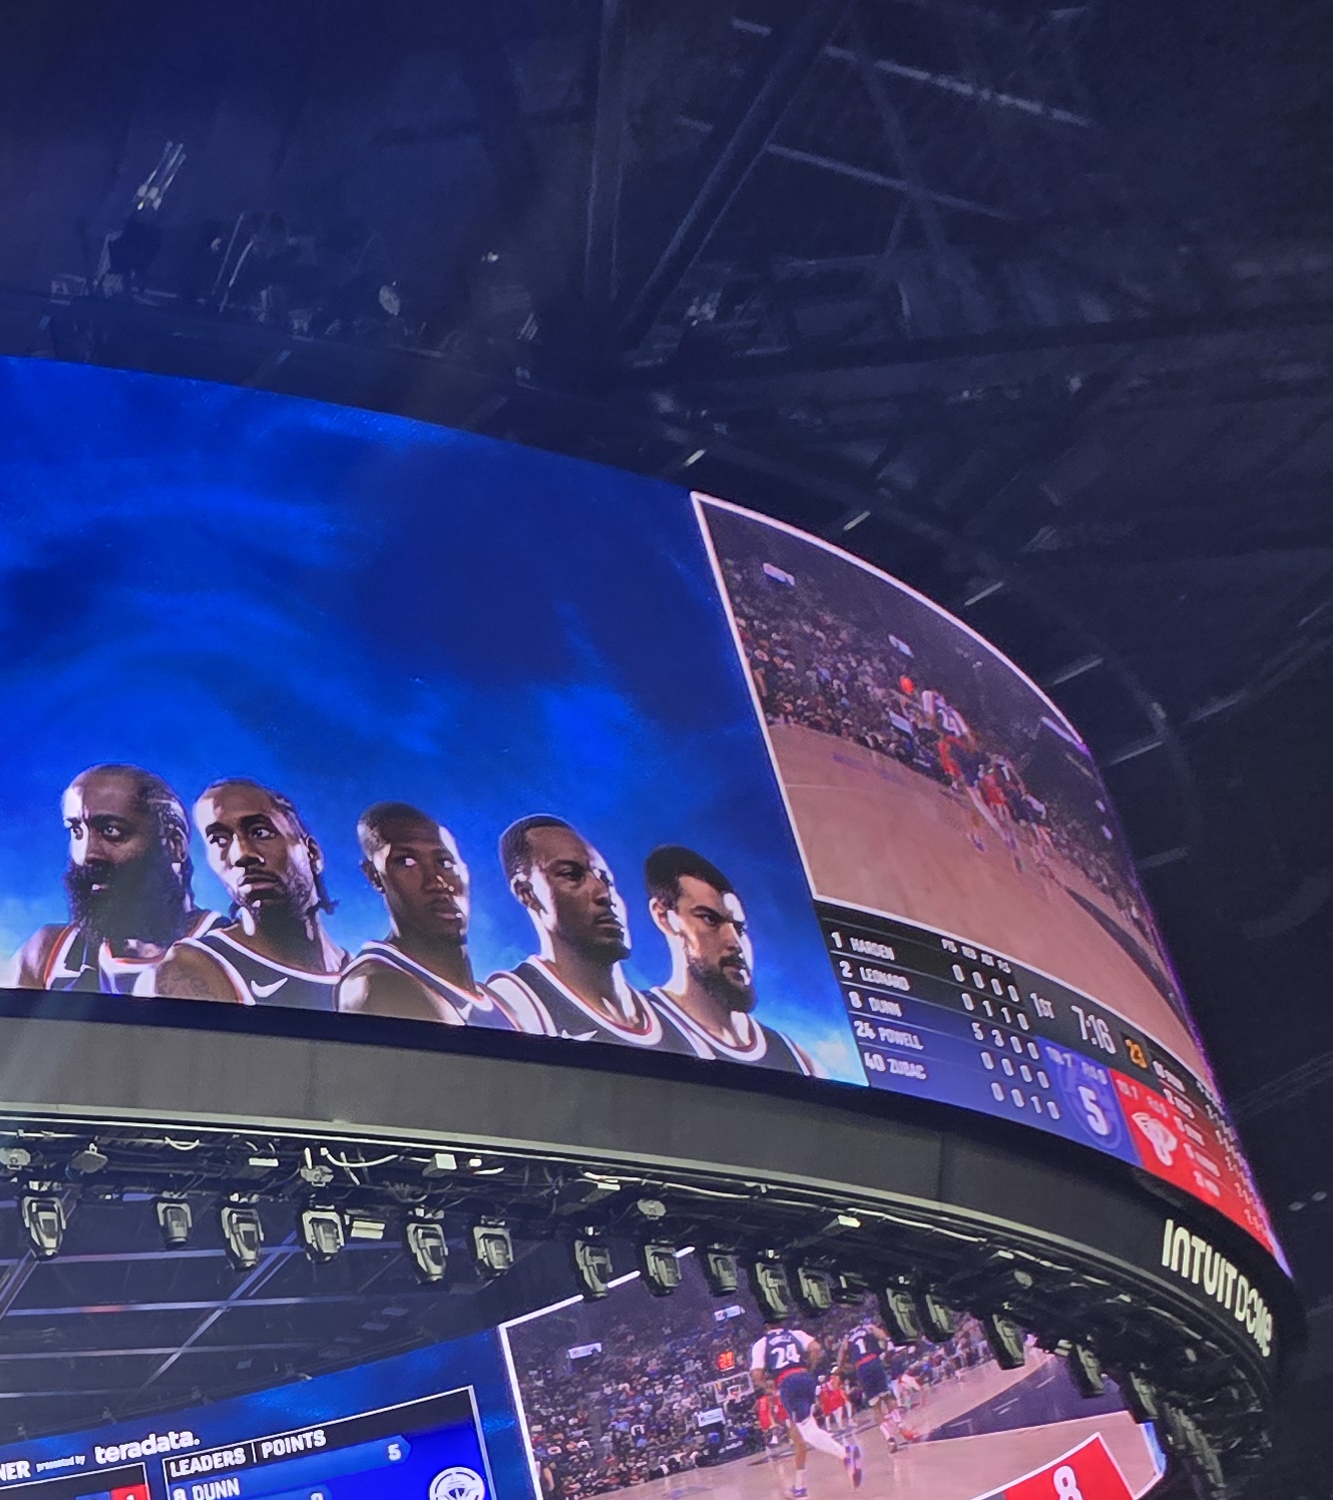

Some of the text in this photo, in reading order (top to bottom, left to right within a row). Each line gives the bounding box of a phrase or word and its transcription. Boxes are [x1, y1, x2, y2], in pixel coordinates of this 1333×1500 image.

[1072, 1005, 1116, 1054] 7:16
[1078, 1086, 1110, 1136] 5
[1162, 1219, 1237, 1309] INTUIT
[170, 1430, 326, 1477] LEADERS POINTS
